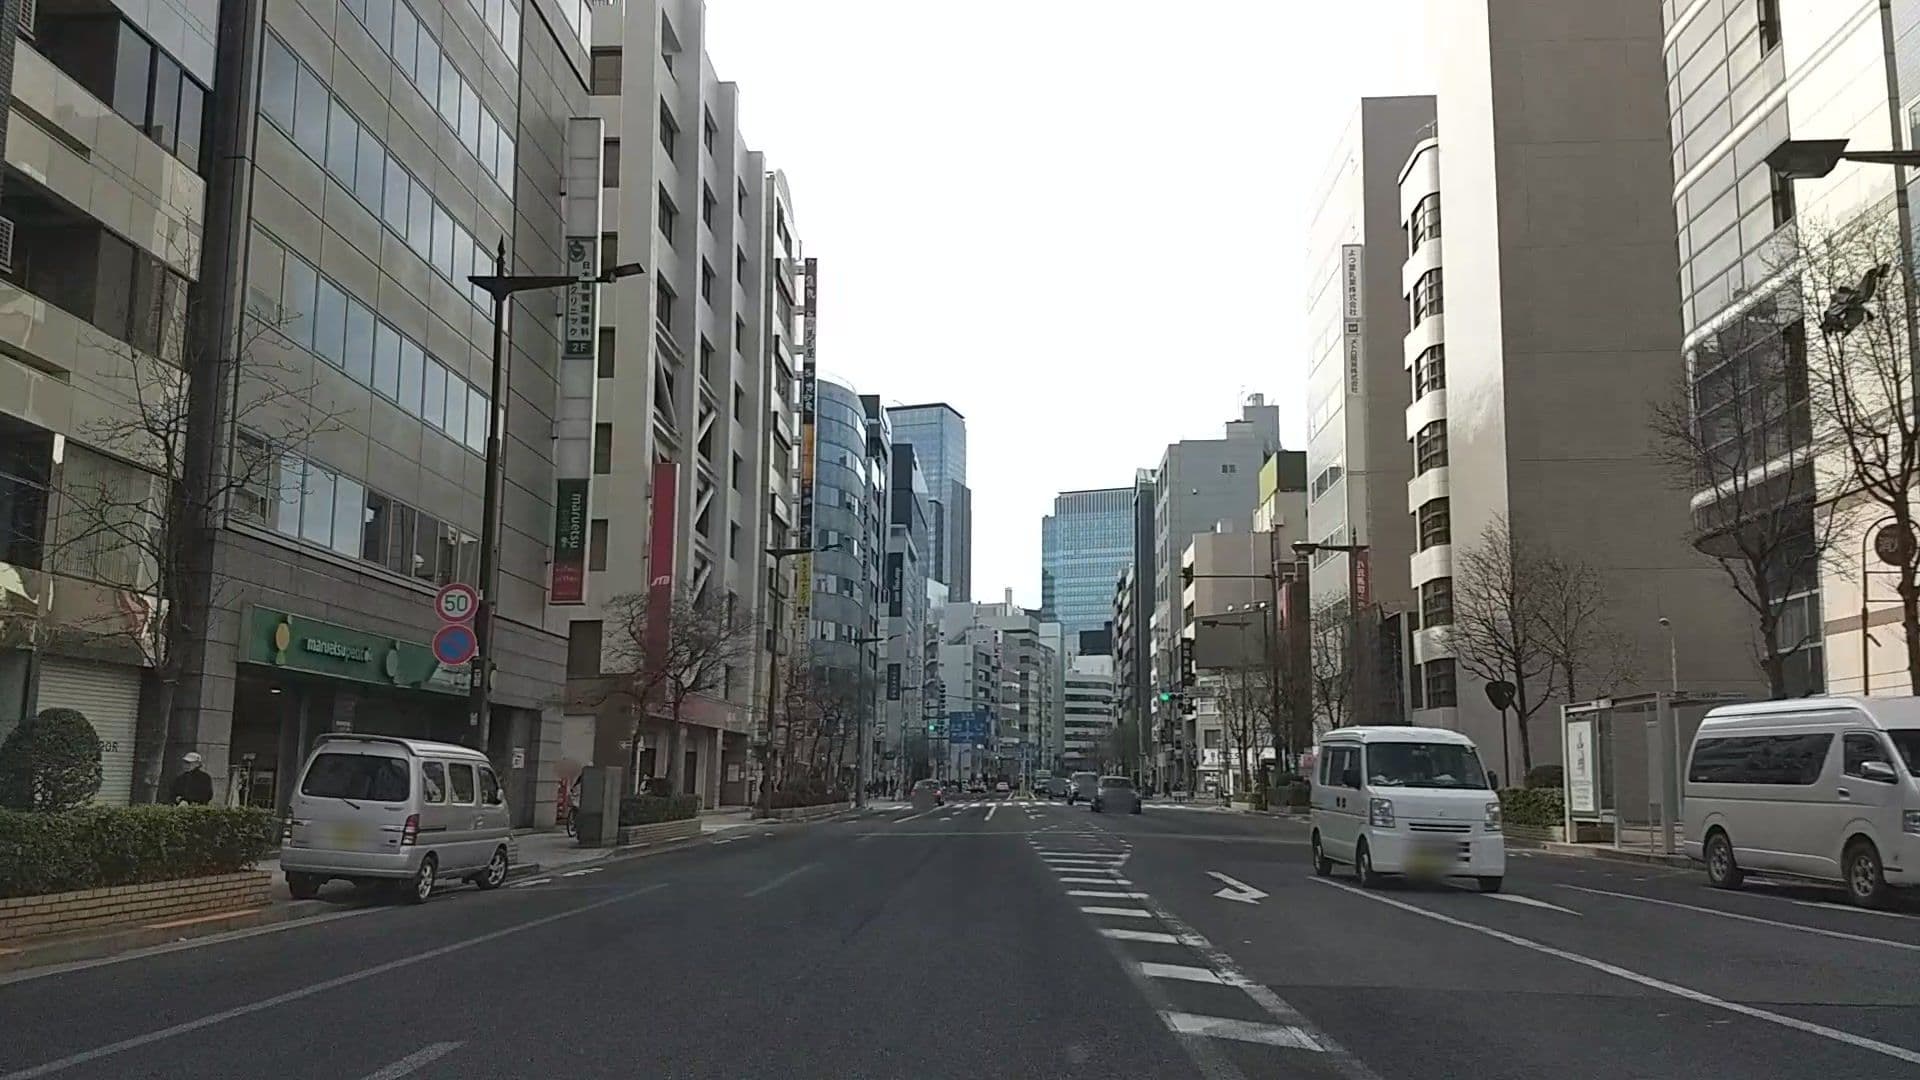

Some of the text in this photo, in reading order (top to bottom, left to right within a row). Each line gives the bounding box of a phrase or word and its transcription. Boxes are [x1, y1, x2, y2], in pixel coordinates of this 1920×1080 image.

[569, 285, 578, 336] クリニック
[572, 343, 588, 353] 2F
[570, 493, 582, 549] maruetsu
[444, 594, 469, 612] 50
[307, 638, 346, 658] maruetsu
